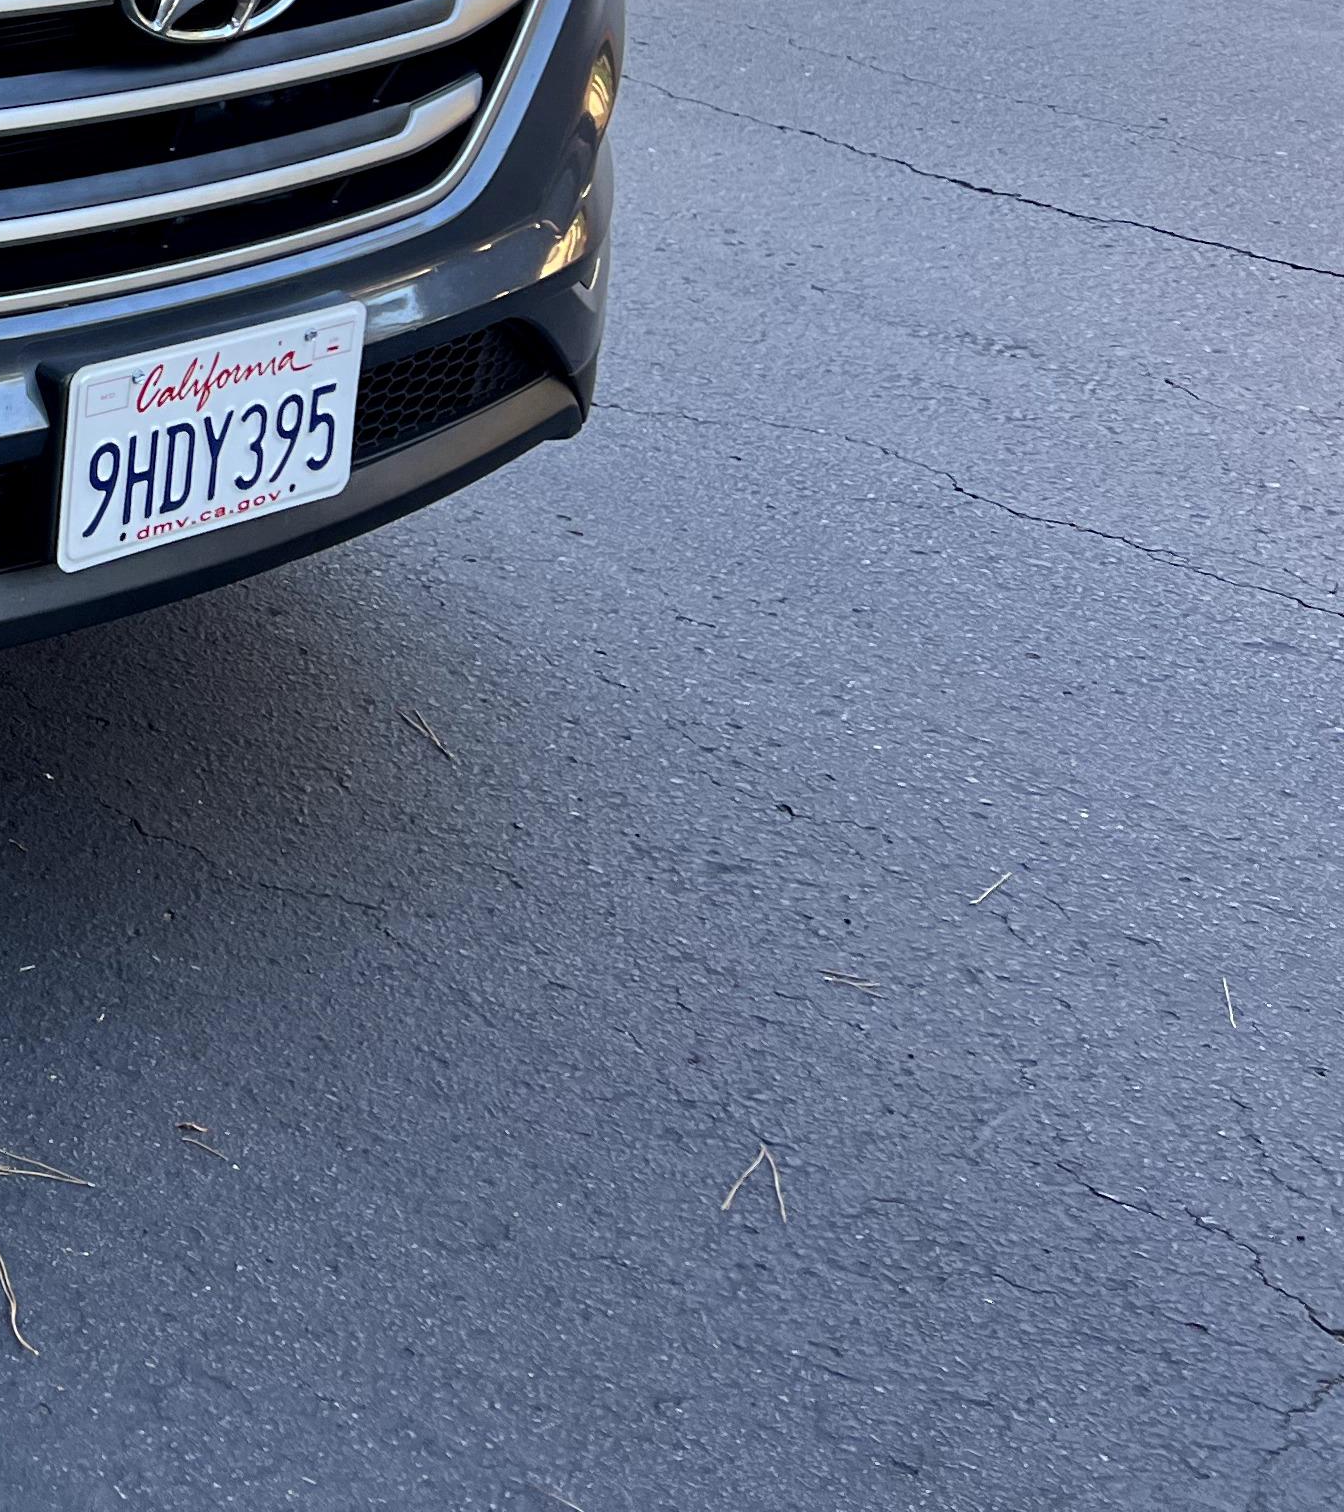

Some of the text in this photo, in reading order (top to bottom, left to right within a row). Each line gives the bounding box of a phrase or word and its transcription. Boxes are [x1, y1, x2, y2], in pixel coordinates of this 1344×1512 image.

[136, 341, 312, 413] California
[82, 383, 337, 538] 9HDY395
[136, 490, 281, 540] dmv.ca.gov
